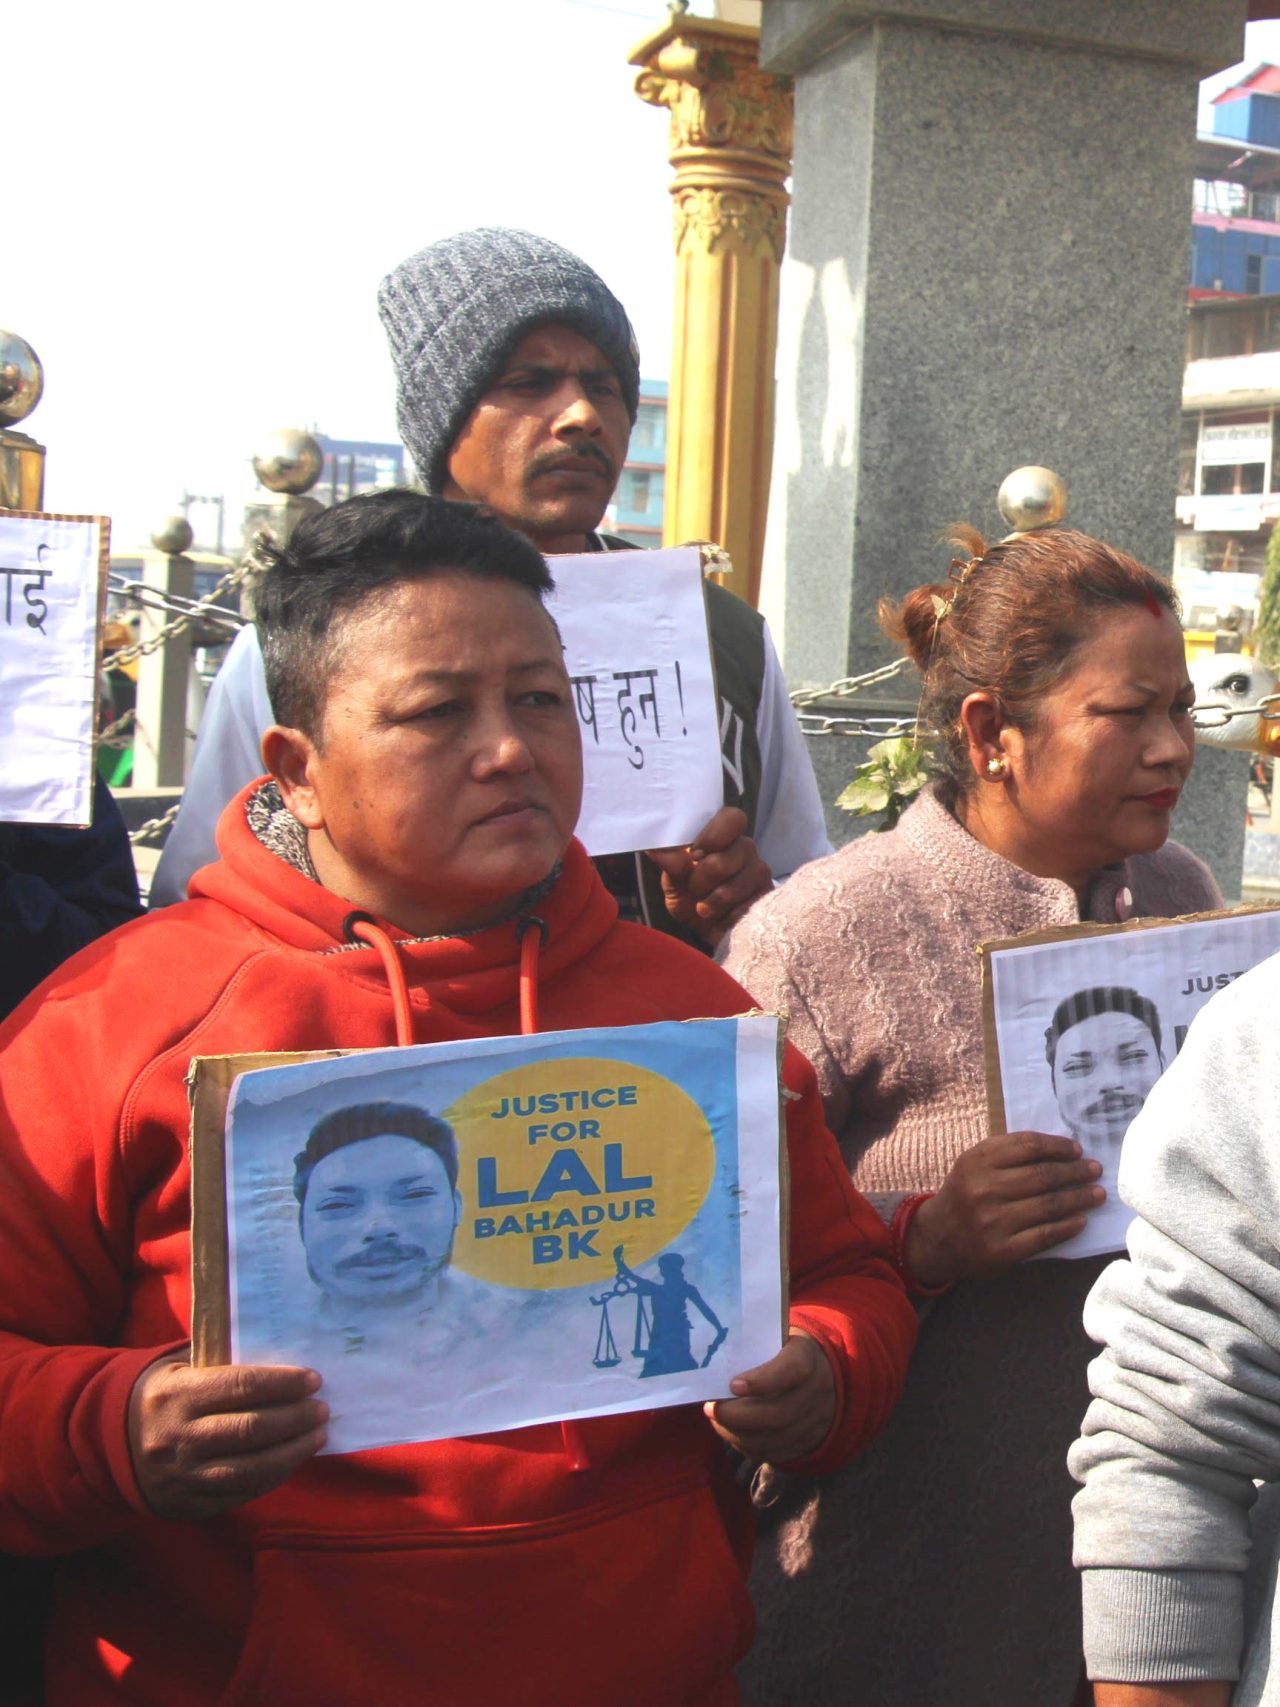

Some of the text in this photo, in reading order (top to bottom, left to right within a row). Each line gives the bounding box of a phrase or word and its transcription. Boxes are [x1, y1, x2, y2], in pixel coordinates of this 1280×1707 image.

[490, 1085, 638, 1119] JUSTICE
[528, 1119, 601, 1145] FOR
[477, 1143, 653, 1209] LAL
[474, 1198, 656, 1239] BAHADUR
[532, 1229, 602, 1265] BK
